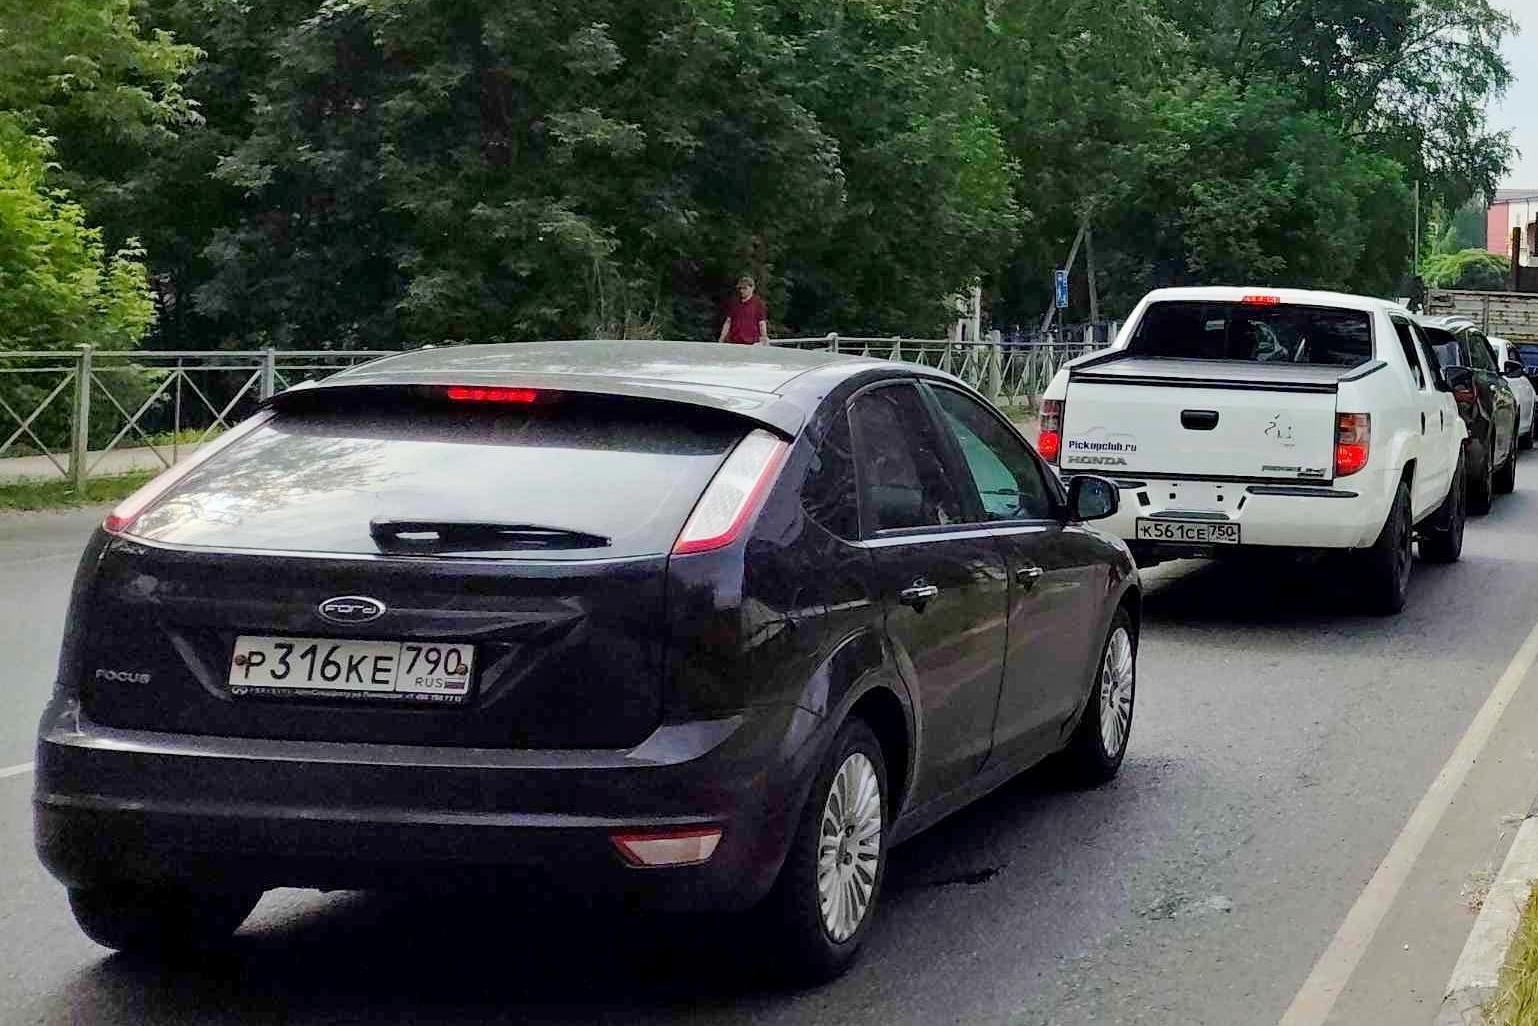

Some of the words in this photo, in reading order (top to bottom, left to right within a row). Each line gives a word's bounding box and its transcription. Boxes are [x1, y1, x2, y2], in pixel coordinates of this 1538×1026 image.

[1068, 440, 1137, 452] Pickupclub.ru
[1067, 455, 1128, 466] HONDA
[1209, 525, 1235, 537] 750
[324, 603, 378, 614] Ford
[244, 642, 394, 685] Р316КЕ
[405, 646, 463, 676] 790
[95, 668, 151, 685] FOCUS
[415, 676, 444, 689] RUS
